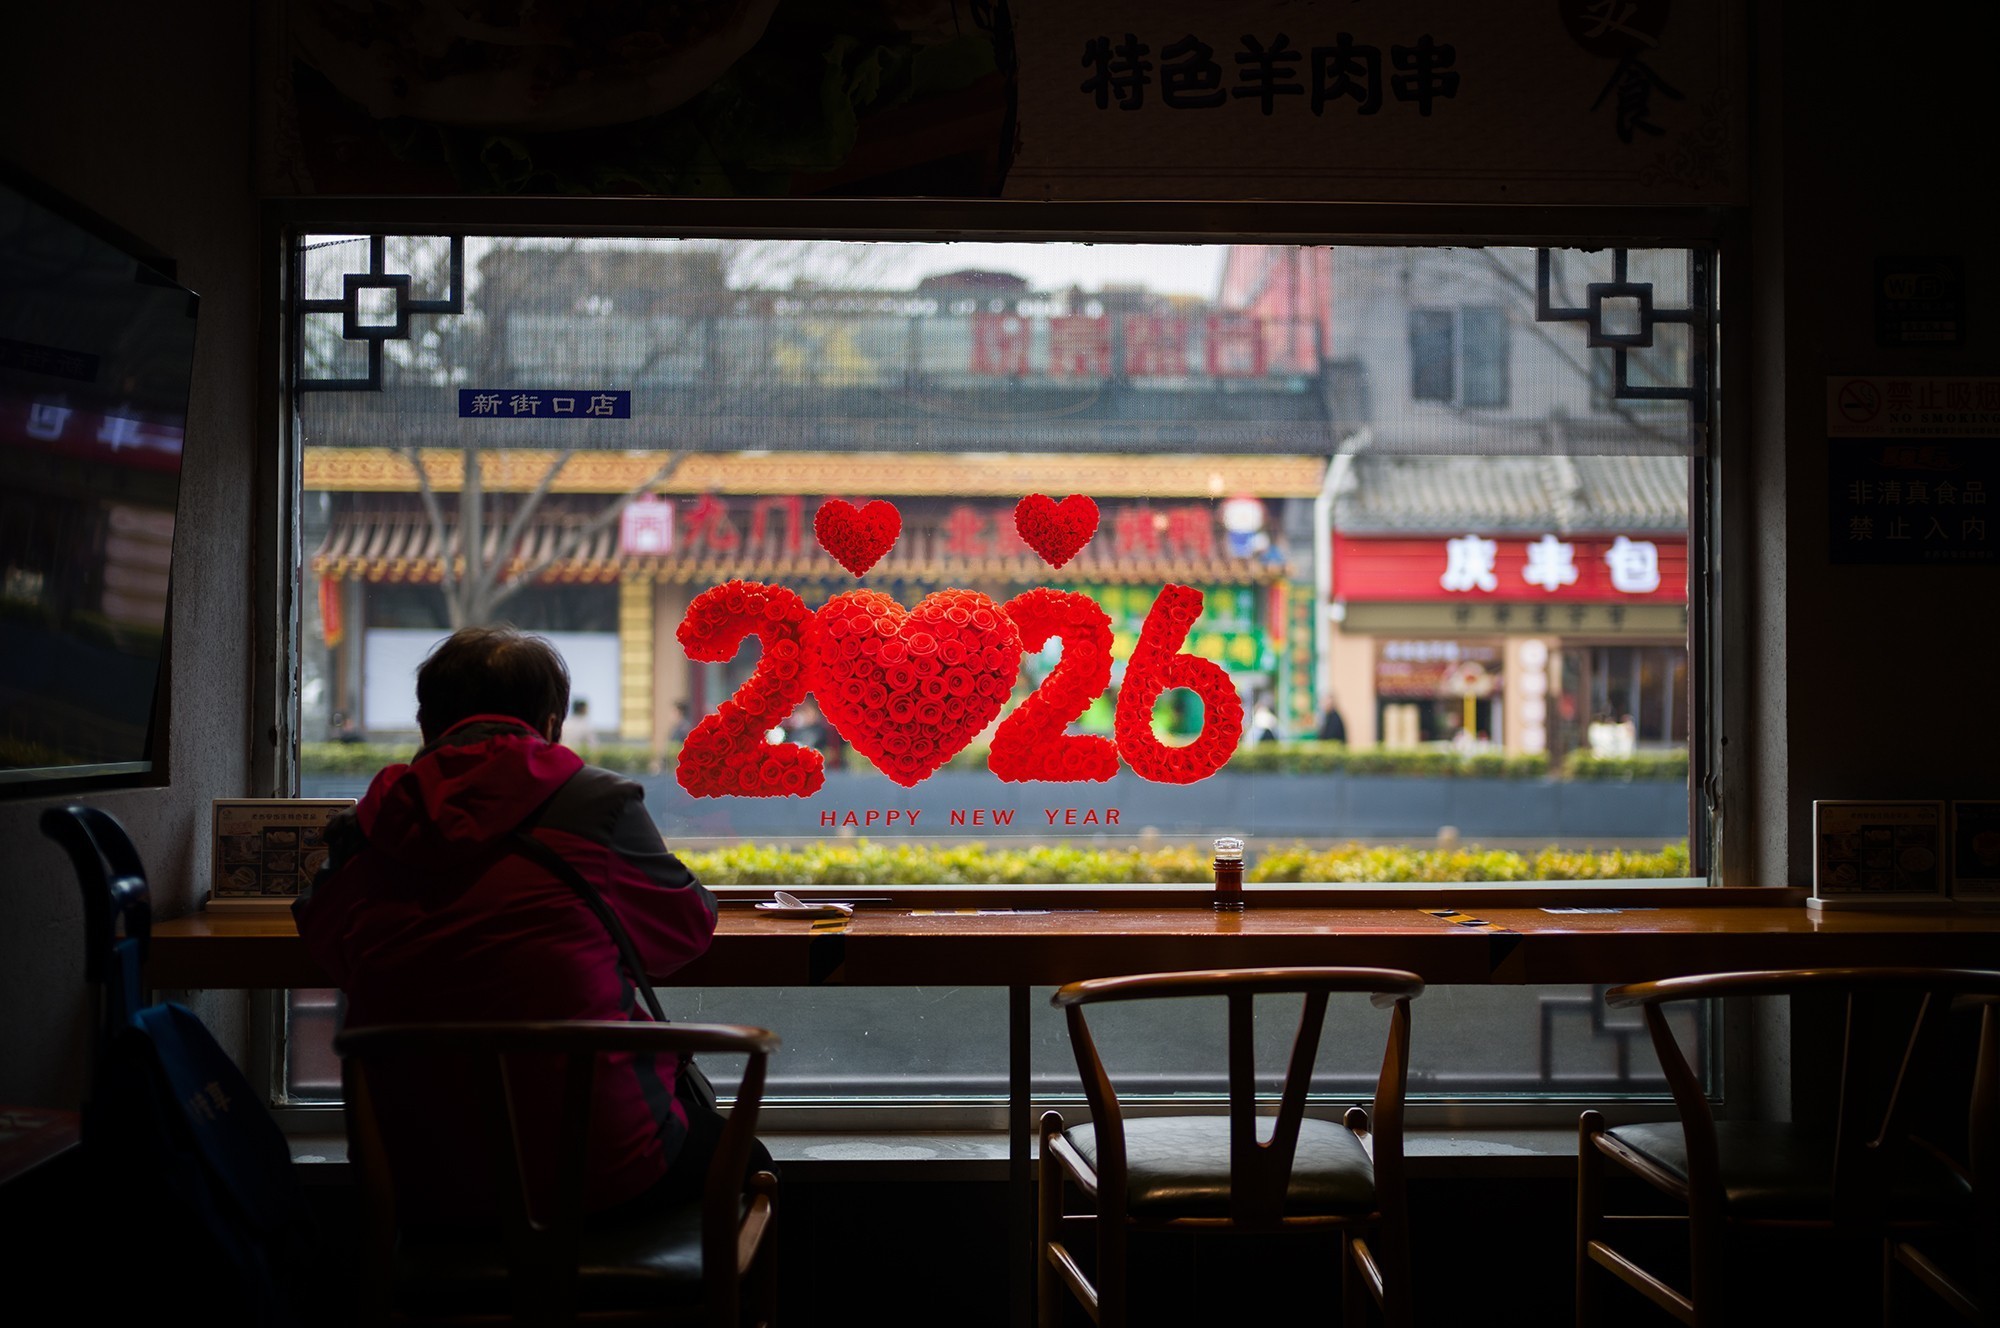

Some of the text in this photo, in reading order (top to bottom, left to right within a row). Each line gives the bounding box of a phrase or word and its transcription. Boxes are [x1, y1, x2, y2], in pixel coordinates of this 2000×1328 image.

[1081, 33, 1460, 116] 特色羊肉串
[471, 394, 617, 416] 新街口店
[1887, 382, 2000, 411] 禁止吸烟
[1889, 413, 2000, 424] NO SMOKING
[1848, 480, 1986, 505] 非清真食品
[1849, 515, 1985, 541] 禁止入内
[820, 808, 1121, 827] HAPPY NEW YEAR
